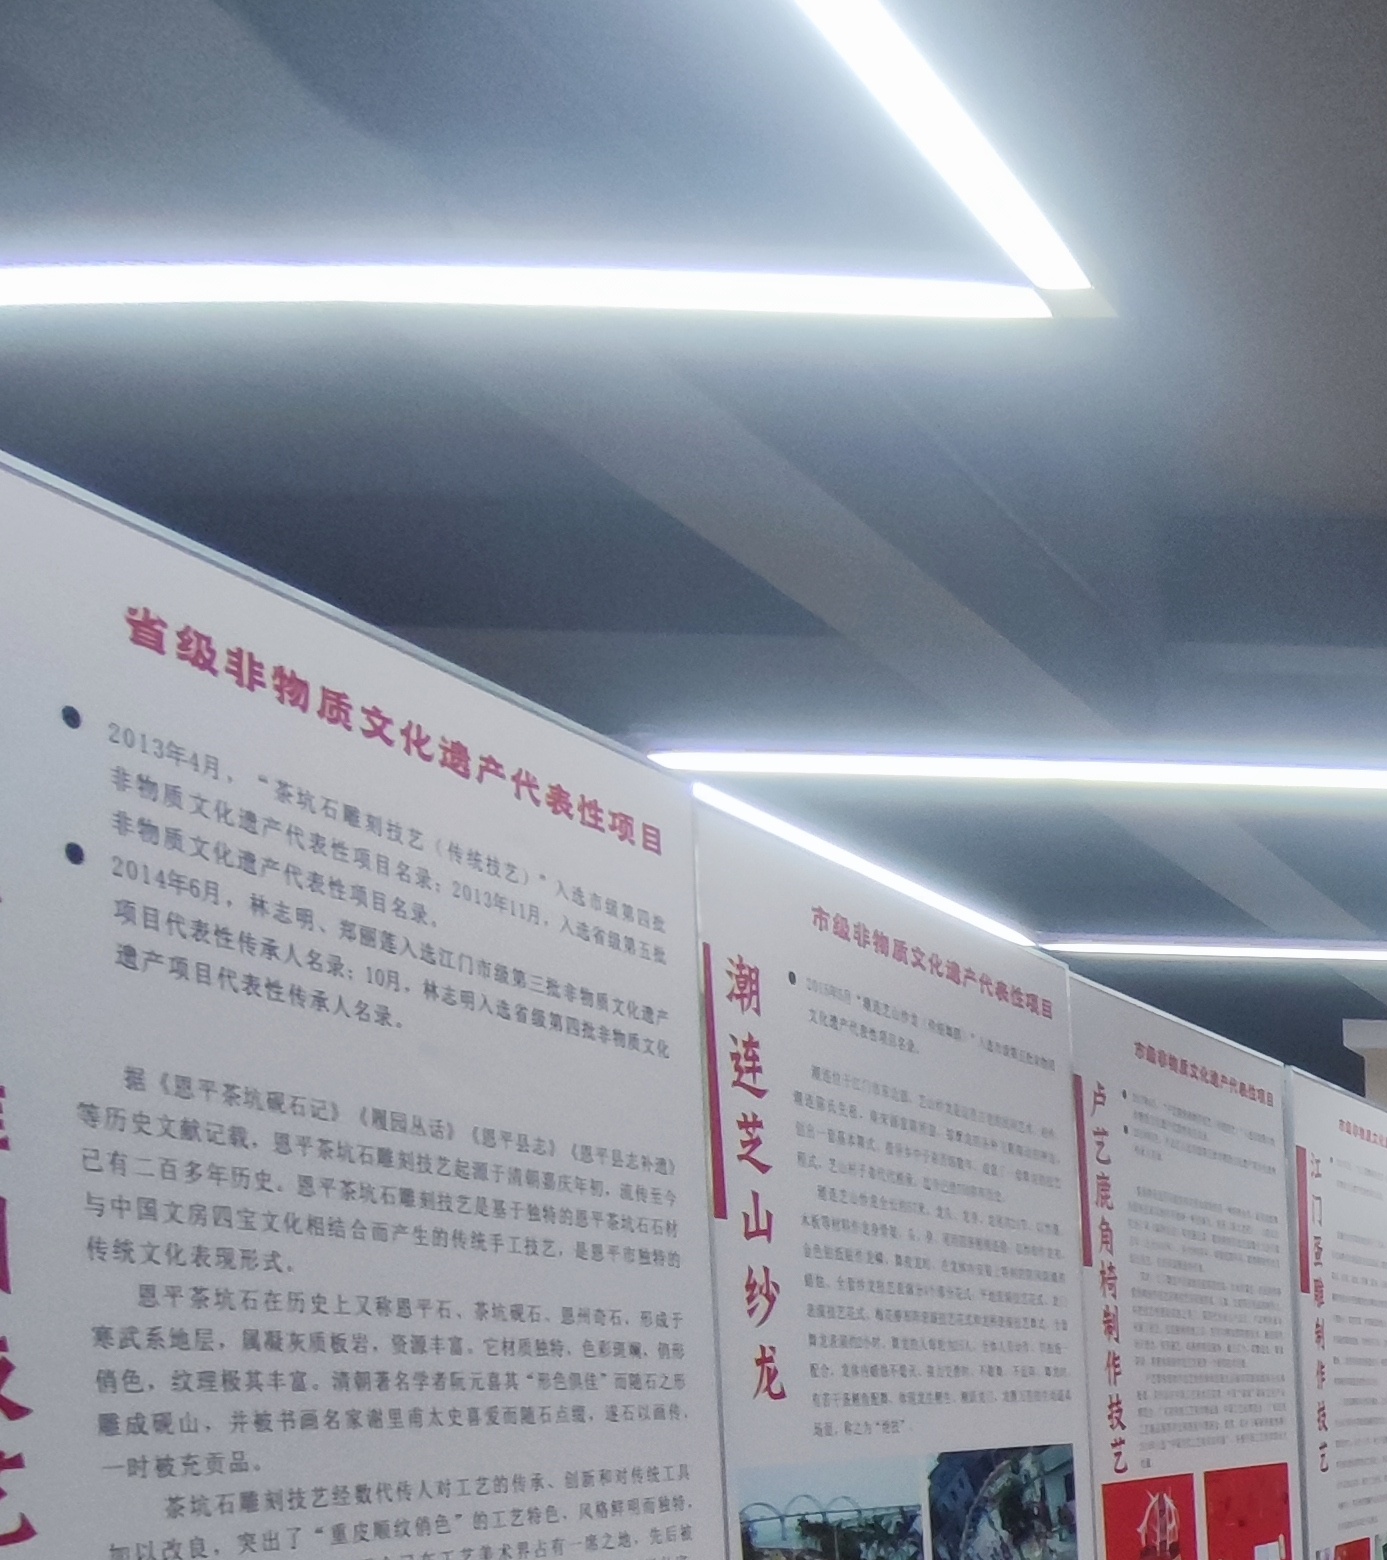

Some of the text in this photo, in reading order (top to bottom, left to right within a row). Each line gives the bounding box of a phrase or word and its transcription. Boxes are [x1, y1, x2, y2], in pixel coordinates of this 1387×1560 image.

[125, 606, 662, 856] 省级非物质文化遗产代表性项目
[811, 905, 1053, 1020] 市级非物质文化遗产代表性项目
[726, 954, 787, 1400] 潮连芝山纱龙
